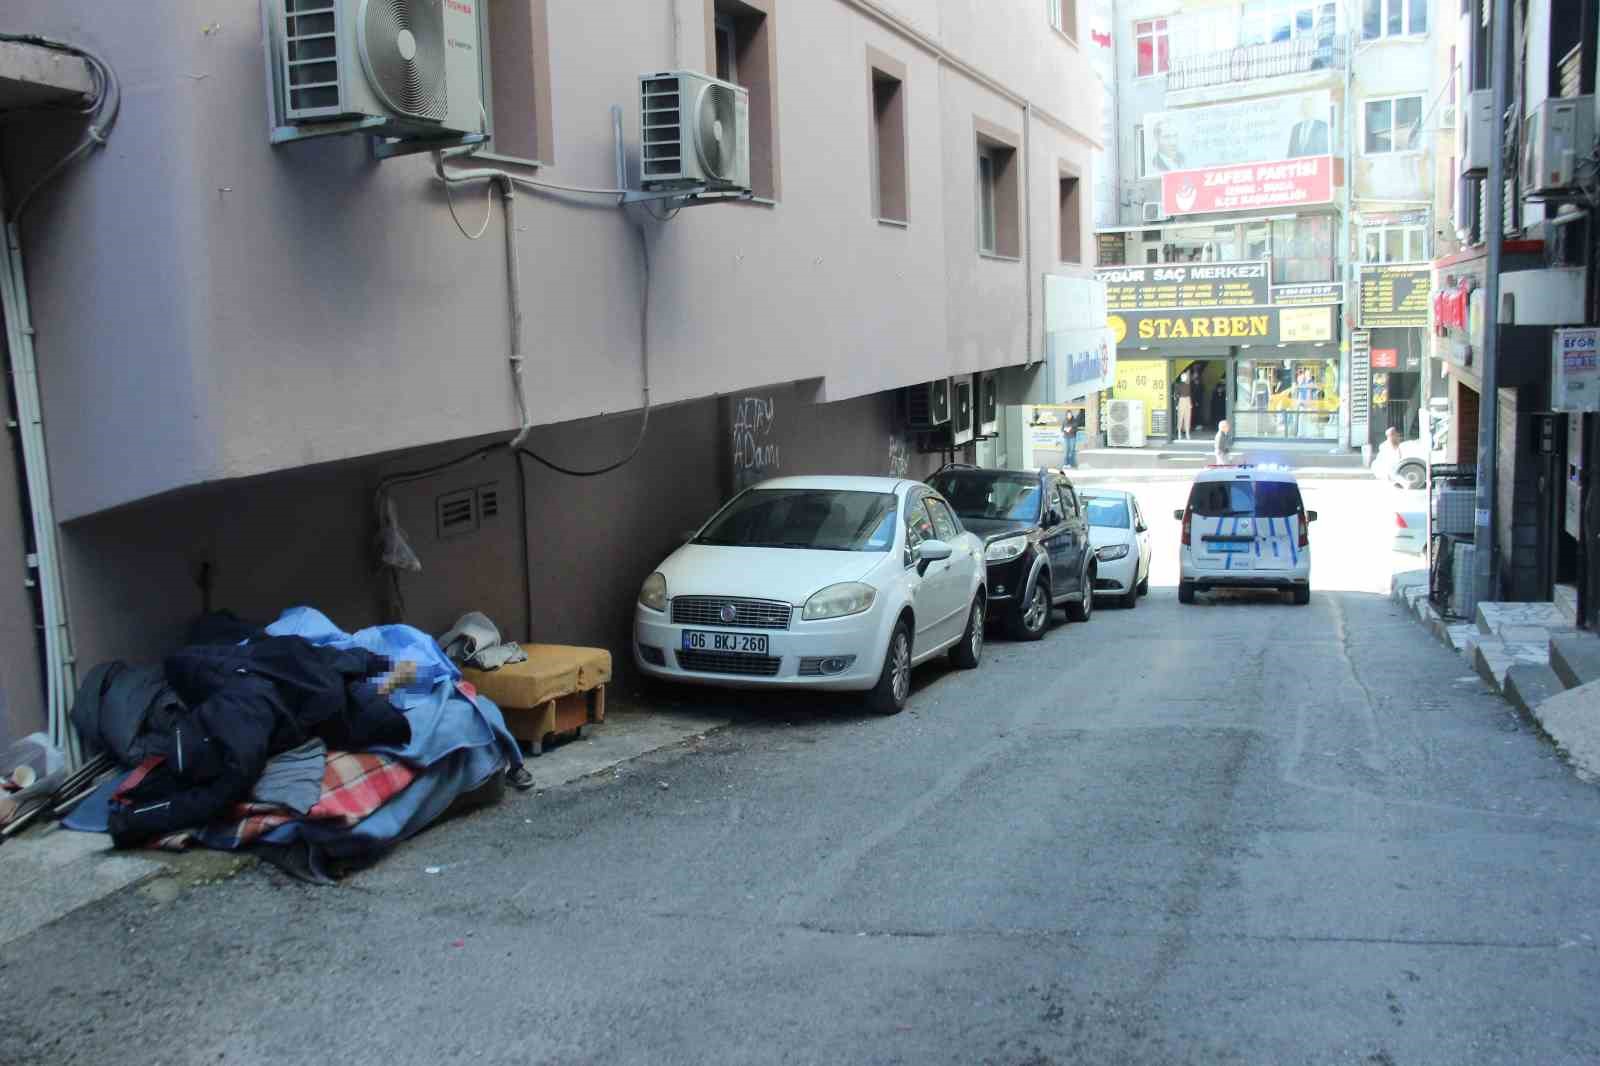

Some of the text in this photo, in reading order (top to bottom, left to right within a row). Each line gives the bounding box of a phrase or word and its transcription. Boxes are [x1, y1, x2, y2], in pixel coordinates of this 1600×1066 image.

[1153, 267, 1186, 283] SAÇ
[1191, 264, 1265, 280] MERKEZİ
[1138, 314, 1269, 339] STARBEN
[691, 632, 765, 652] 06 BKJ 260
